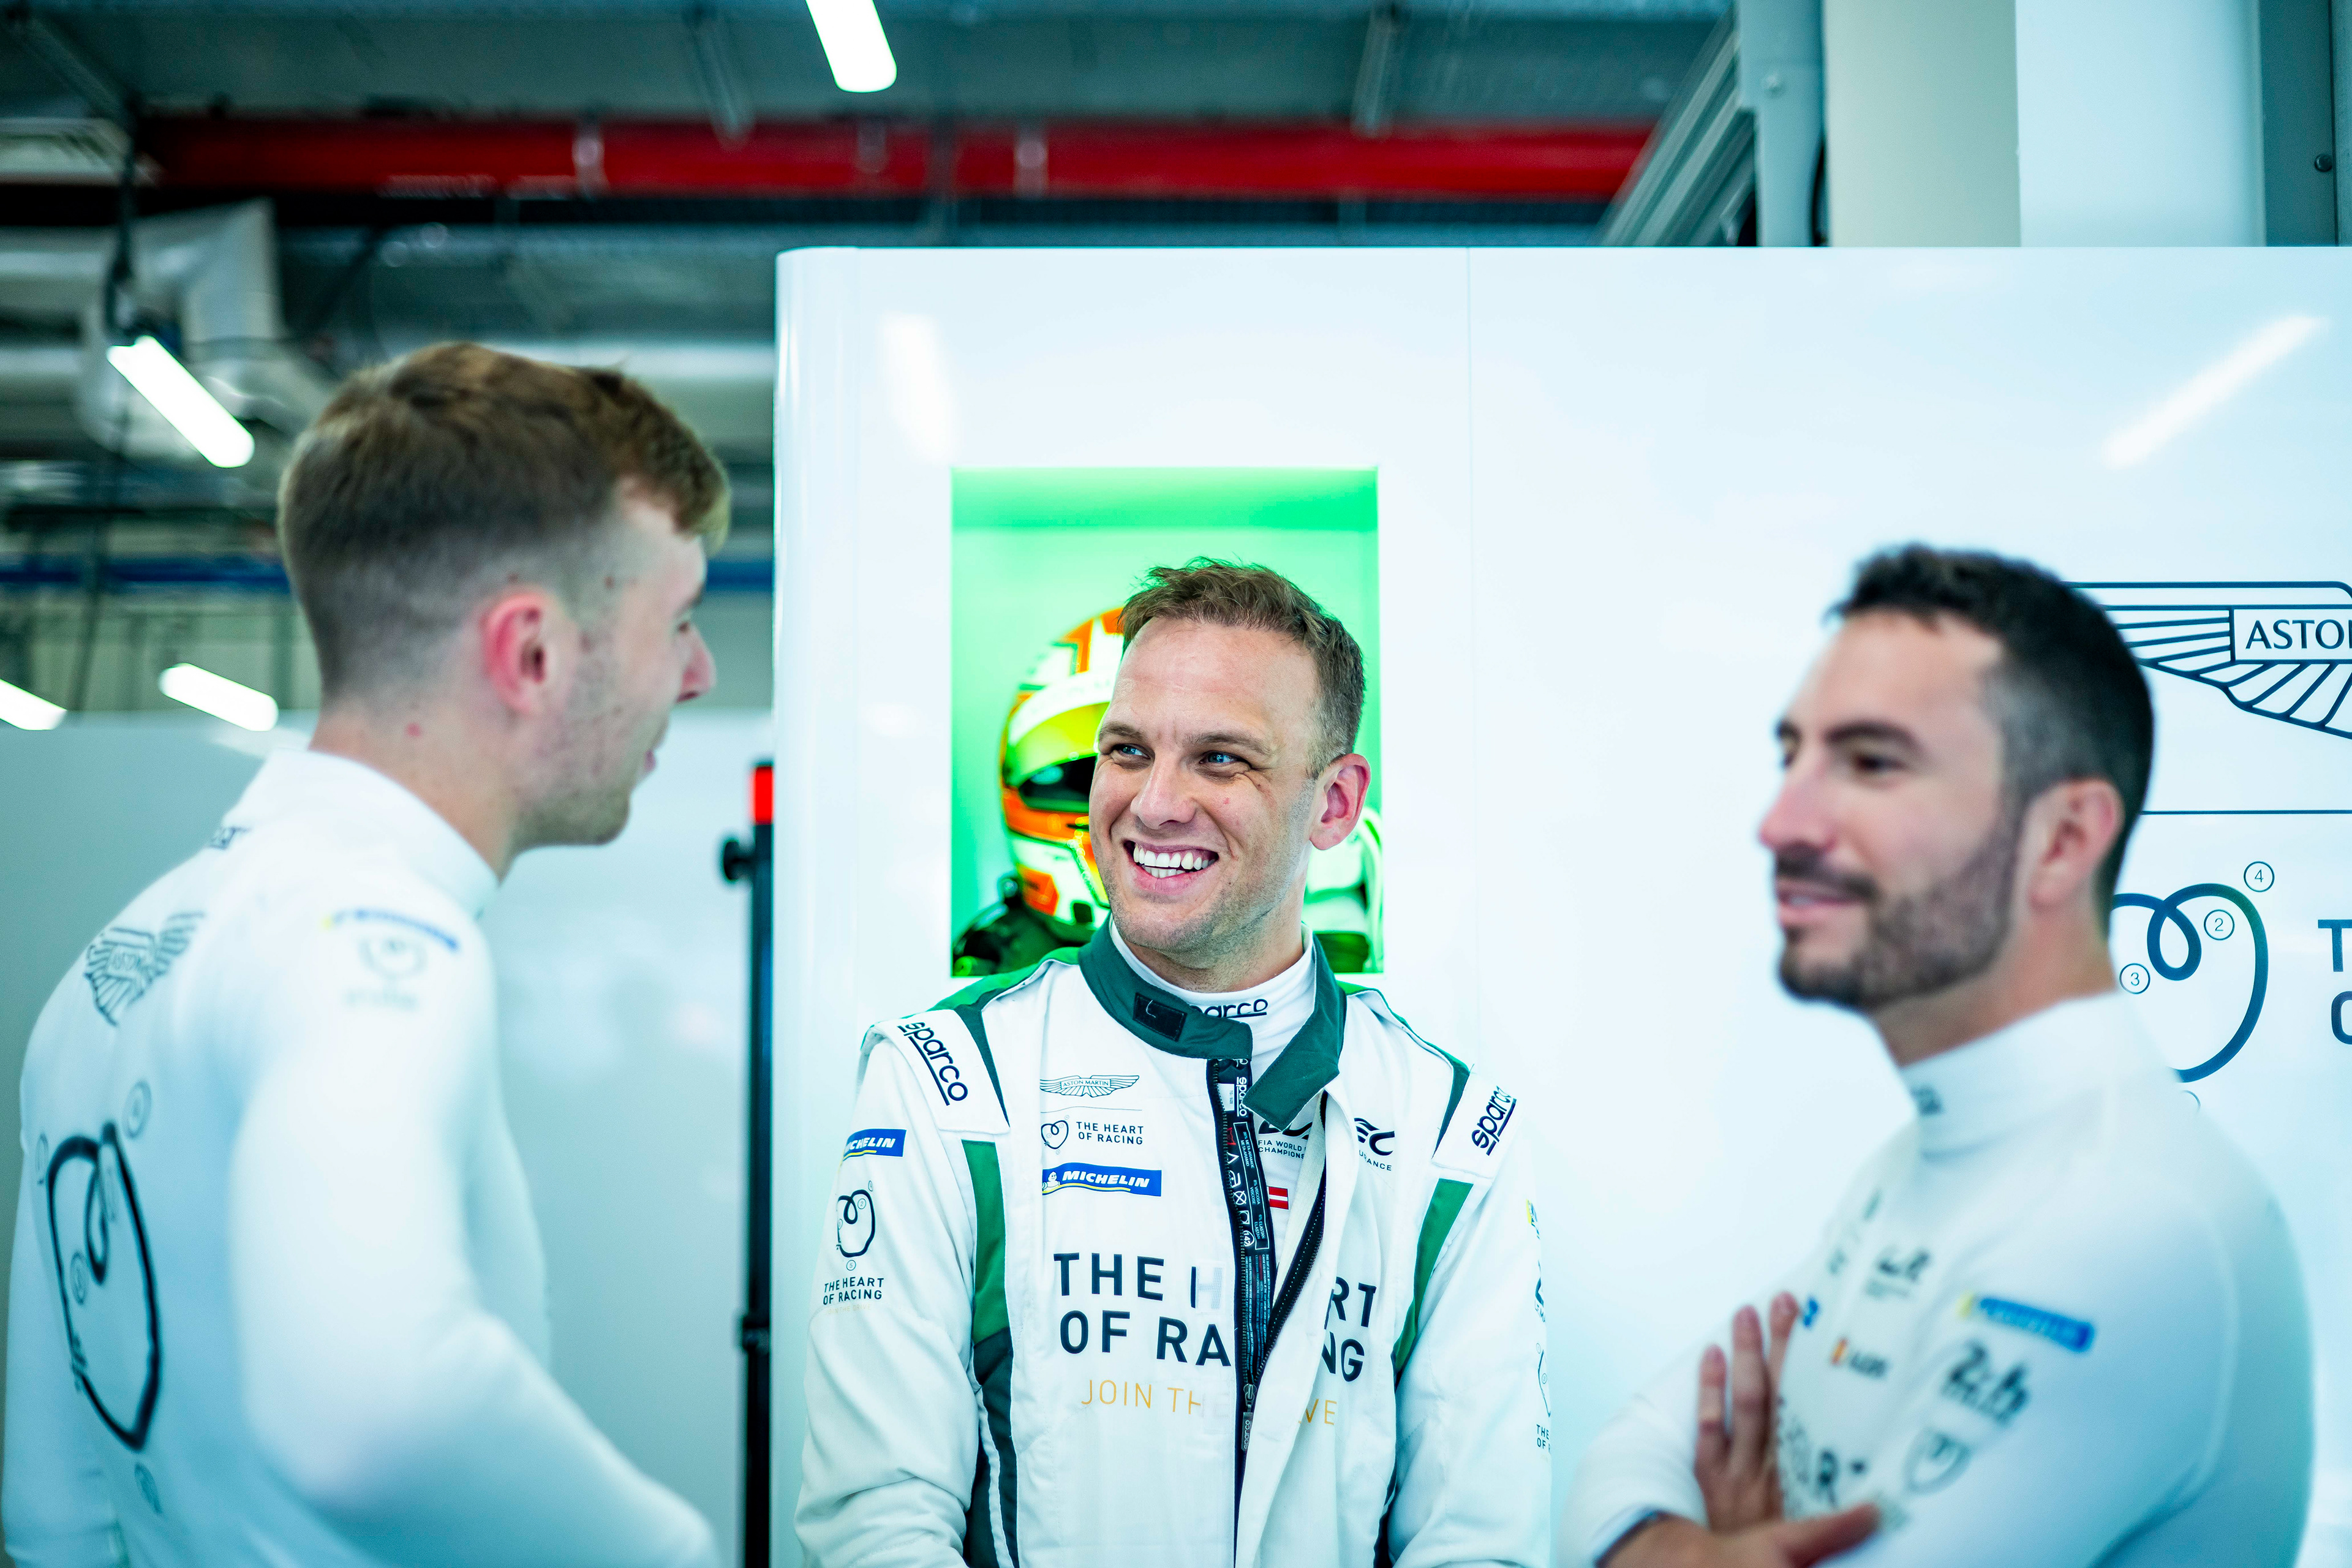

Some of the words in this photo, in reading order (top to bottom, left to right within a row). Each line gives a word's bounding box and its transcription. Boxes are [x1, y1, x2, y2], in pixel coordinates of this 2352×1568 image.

[1189, 998, 1268, 1019] arco
[900, 1022, 968, 1102] sparco
[1076, 1121, 1099, 1131] THE
[1104, 1124, 1144, 1134] HEART
[1078, 1131, 1092, 1140] OF
[1098, 1134, 1144, 1145] RACING
[1275, 1140, 1302, 1152] WORLD
[1257, 1147, 1305, 1159] CHAMPIONS
[1359, 1149, 1392, 1171] URANCE
[1061, 1170, 1150, 1188] MICHELIN
[824, 1279, 840, 1293] THE
[842, 1276, 884, 1289] HEART
[1053, 1252, 1164, 1301] THE
[823, 1293, 835, 1305] OF
[838, 1289, 883, 1303] RACING
[1060, 1310, 1131, 1354] OF
[1081, 1379, 1152, 1409] JOIN
[1536, 1423, 1550, 1441] THE
[1536, 1437, 1546, 1449] OF
